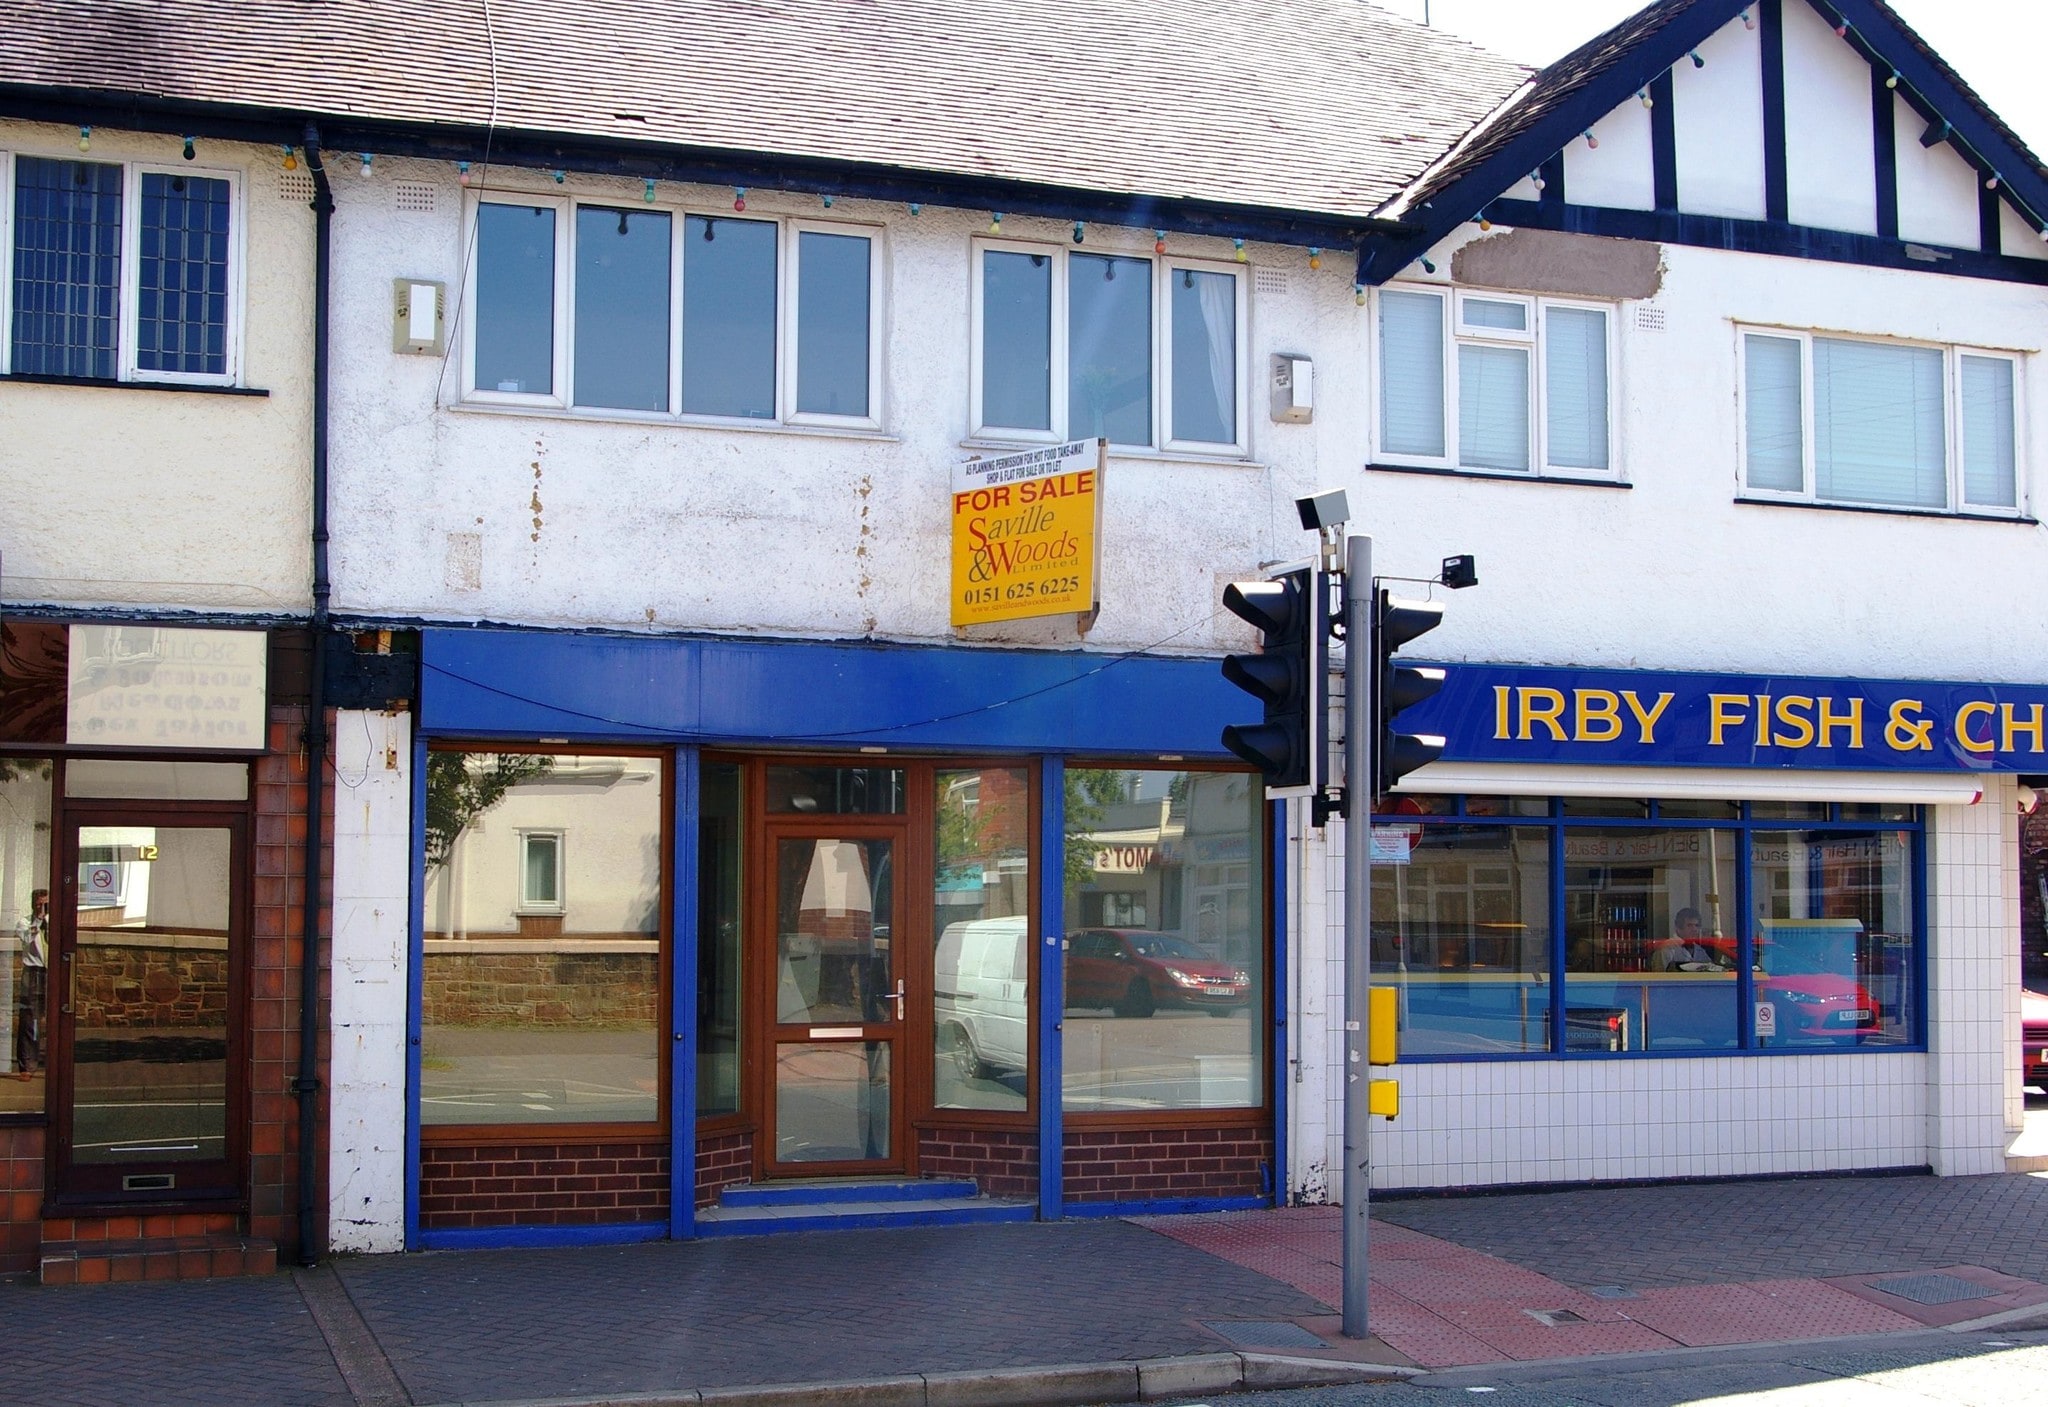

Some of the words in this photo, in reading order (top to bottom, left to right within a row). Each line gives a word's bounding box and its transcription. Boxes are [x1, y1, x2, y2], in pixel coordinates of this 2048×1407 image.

[973, 460, 995, 474] PLANNING
[996, 454, 1024, 471] PERMISSION
[1024, 453, 1033, 466] FOR
[1034, 451, 1043, 463] HOT
[1044, 448, 1056, 461] FOOD
[986, 472, 999, 484] SHOP
[1004, 468, 1015, 481] FLAT
[1016, 466, 1025, 479] FOR
[1026, 464, 1038, 477] SALE
[1038, 463, 1045, 475] OR
[1046, 461, 1052, 473] TO
[1053, 460, 1062, 472] LET
[956, 486, 1010, 514] FOR
[1019, 471, 1093, 504] SALE
[969, 505, 1055, 551] Saville
[968, 550, 993, 583] &
[986, 531, 1079, 576] Woods
[1013, 557, 1079, 574] Limited
[964, 587, 999, 605] 0151
[1006, 582, 1034, 599] 625
[1040, 576, 1079, 595] 6225
[1492, 685, 1676, 744] IRBY
[1707, 692, 1864, 749] FISH
[1884, 699, 1934, 752] &
[139, 845, 159, 861] 12
